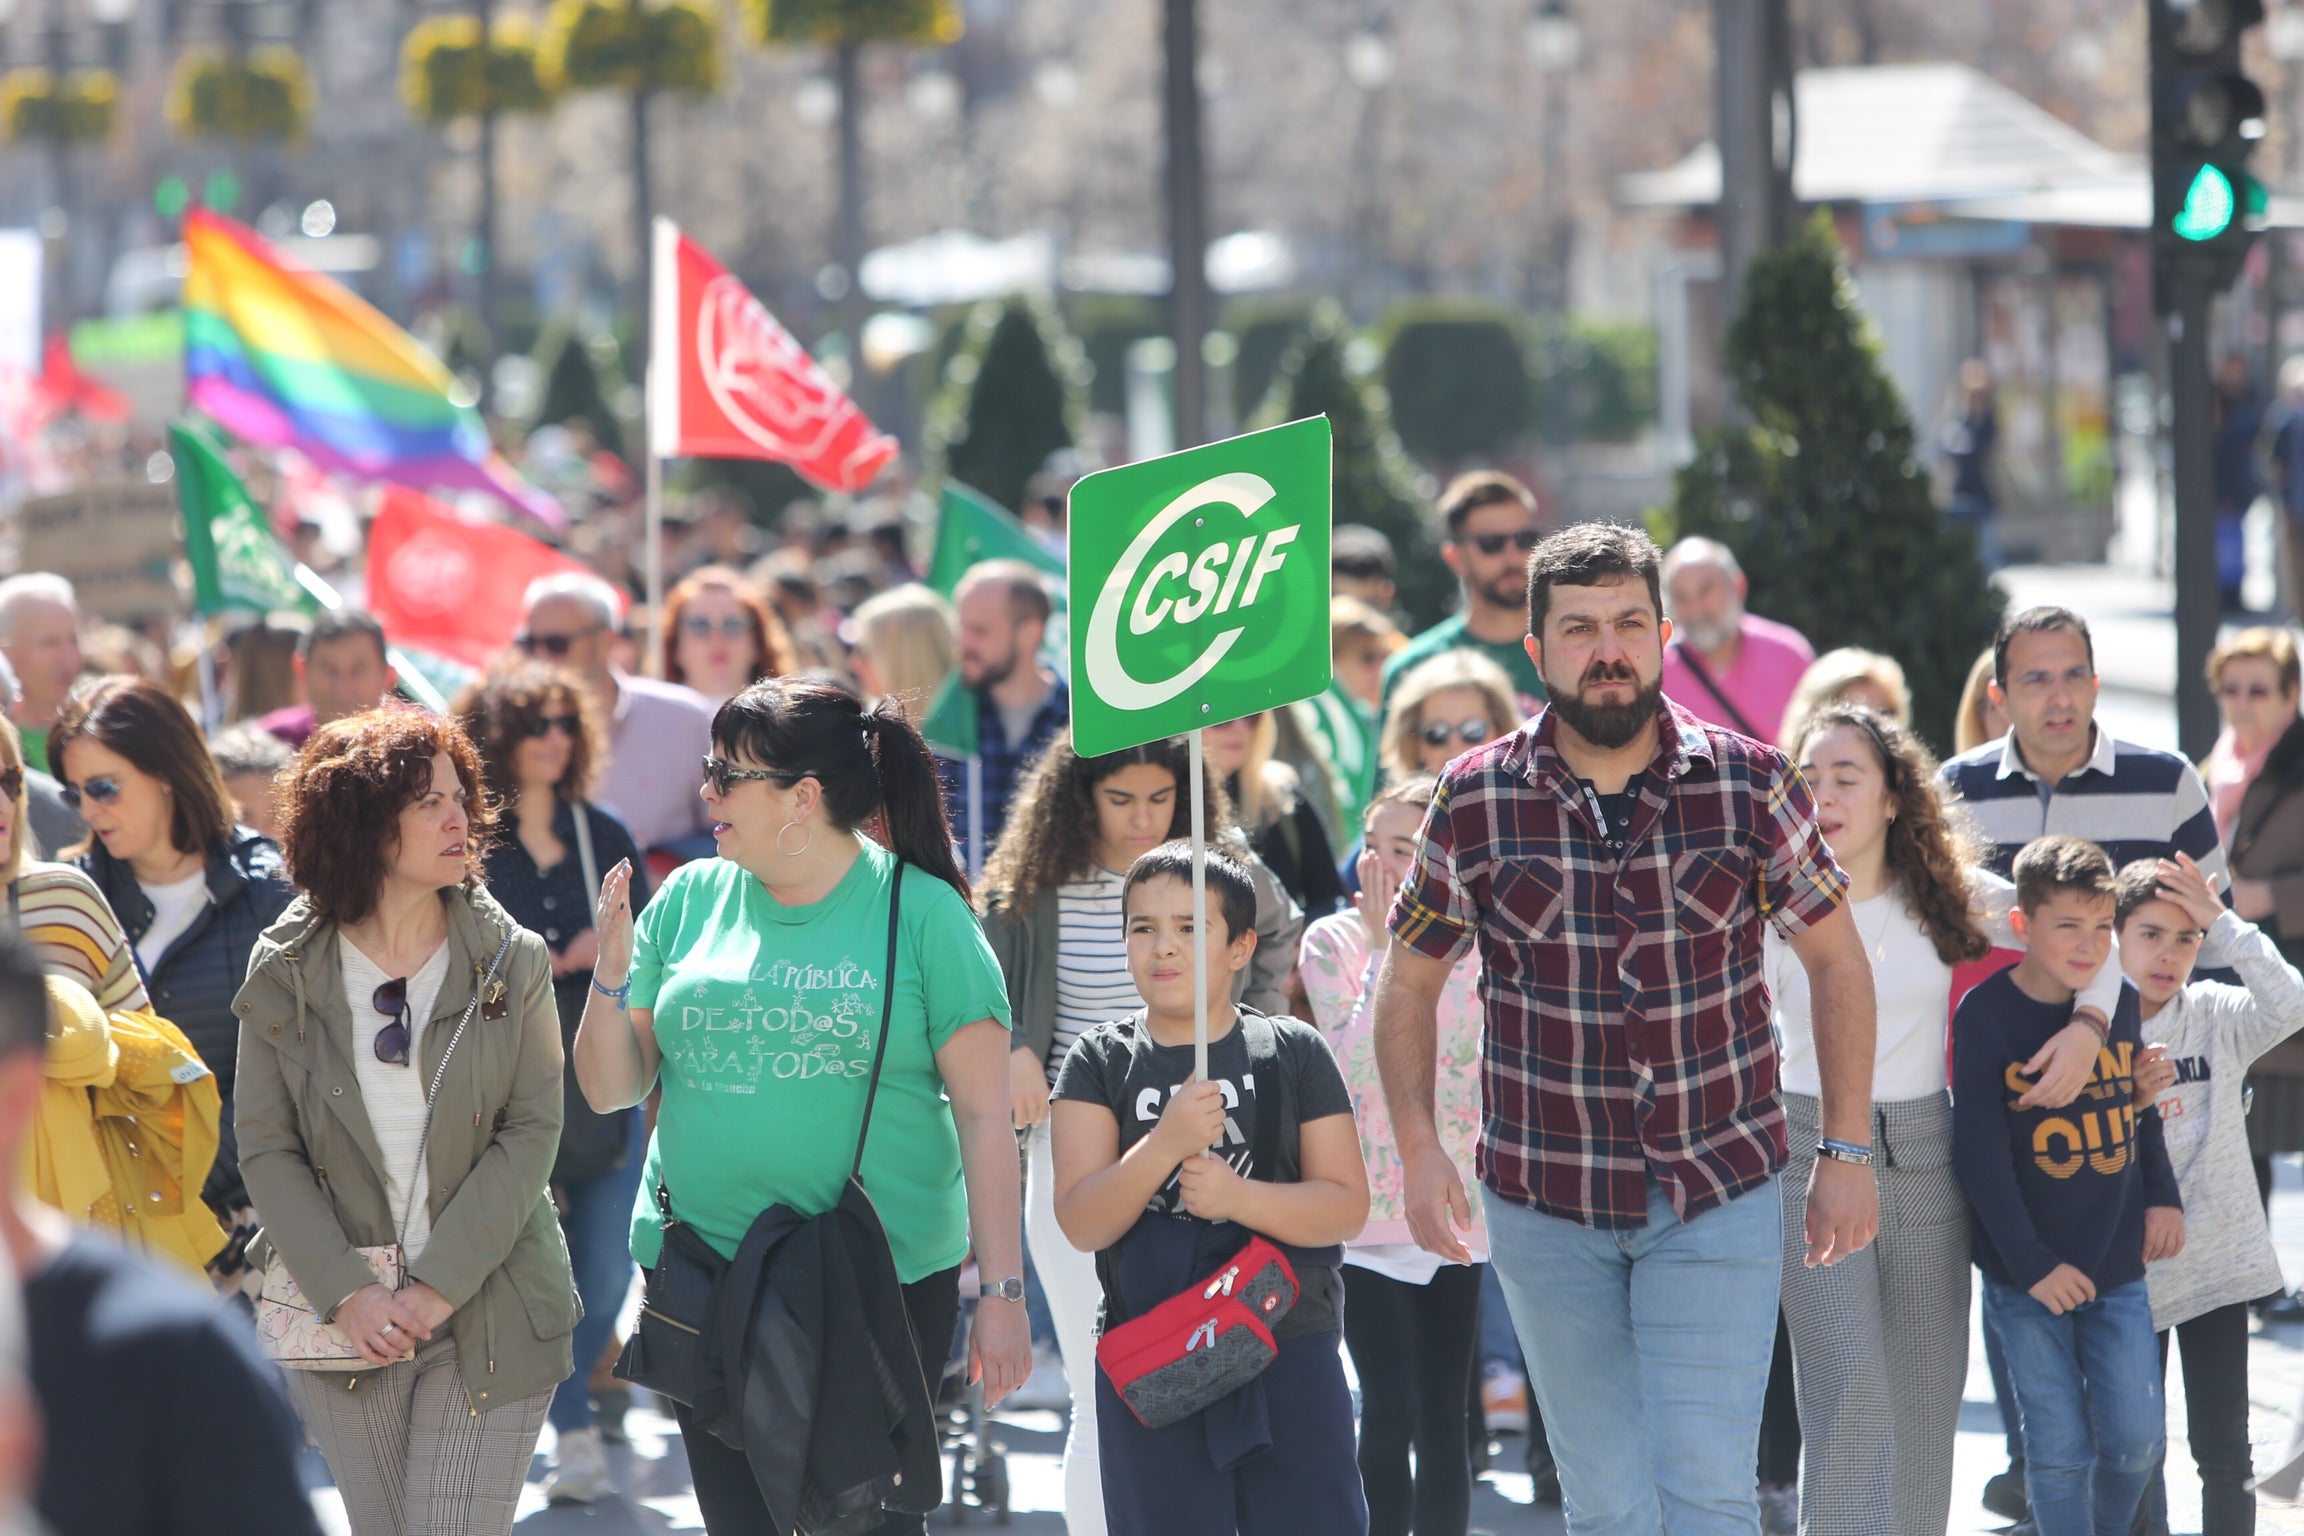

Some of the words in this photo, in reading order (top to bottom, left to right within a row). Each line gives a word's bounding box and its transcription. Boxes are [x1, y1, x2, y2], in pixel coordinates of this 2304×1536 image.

[1129, 524, 1300, 635] CSIF
[750, 963, 778, 986] LA
[682, 1006, 732, 1031] DE
[739, 1006, 858, 1038] TOD@S
[749, 1051, 869, 1080] TOD@S
